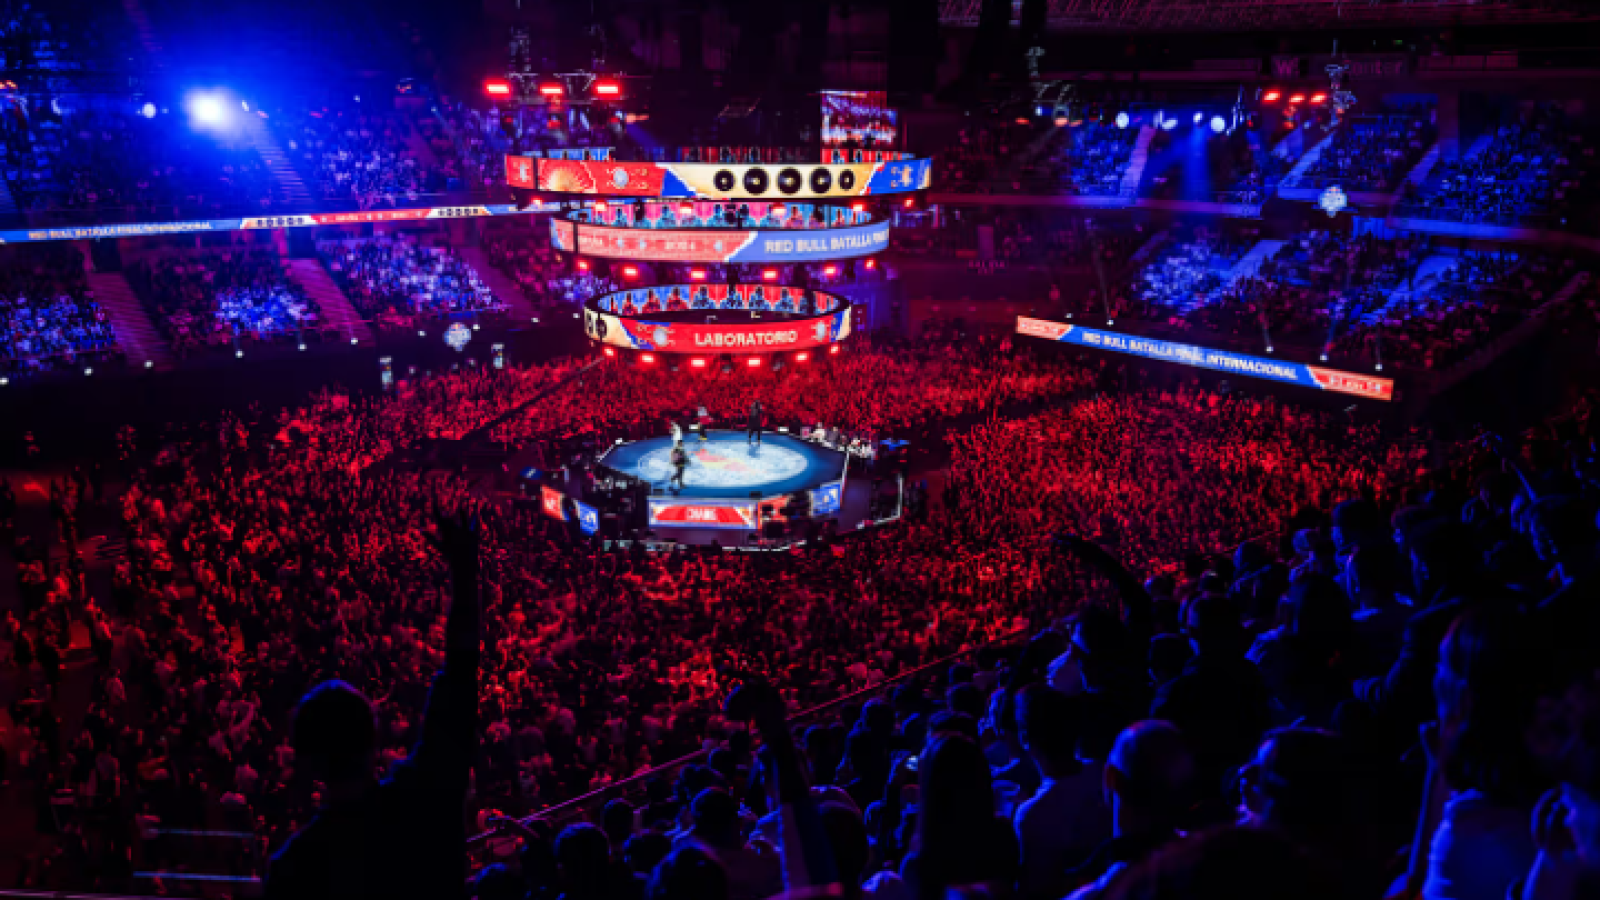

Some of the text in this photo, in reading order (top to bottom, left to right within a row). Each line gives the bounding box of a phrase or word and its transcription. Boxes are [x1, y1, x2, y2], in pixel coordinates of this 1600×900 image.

[765, 240, 793, 253] RED
[796, 239, 828, 252] BULL
[694, 330, 798, 347] LABORATORIO
